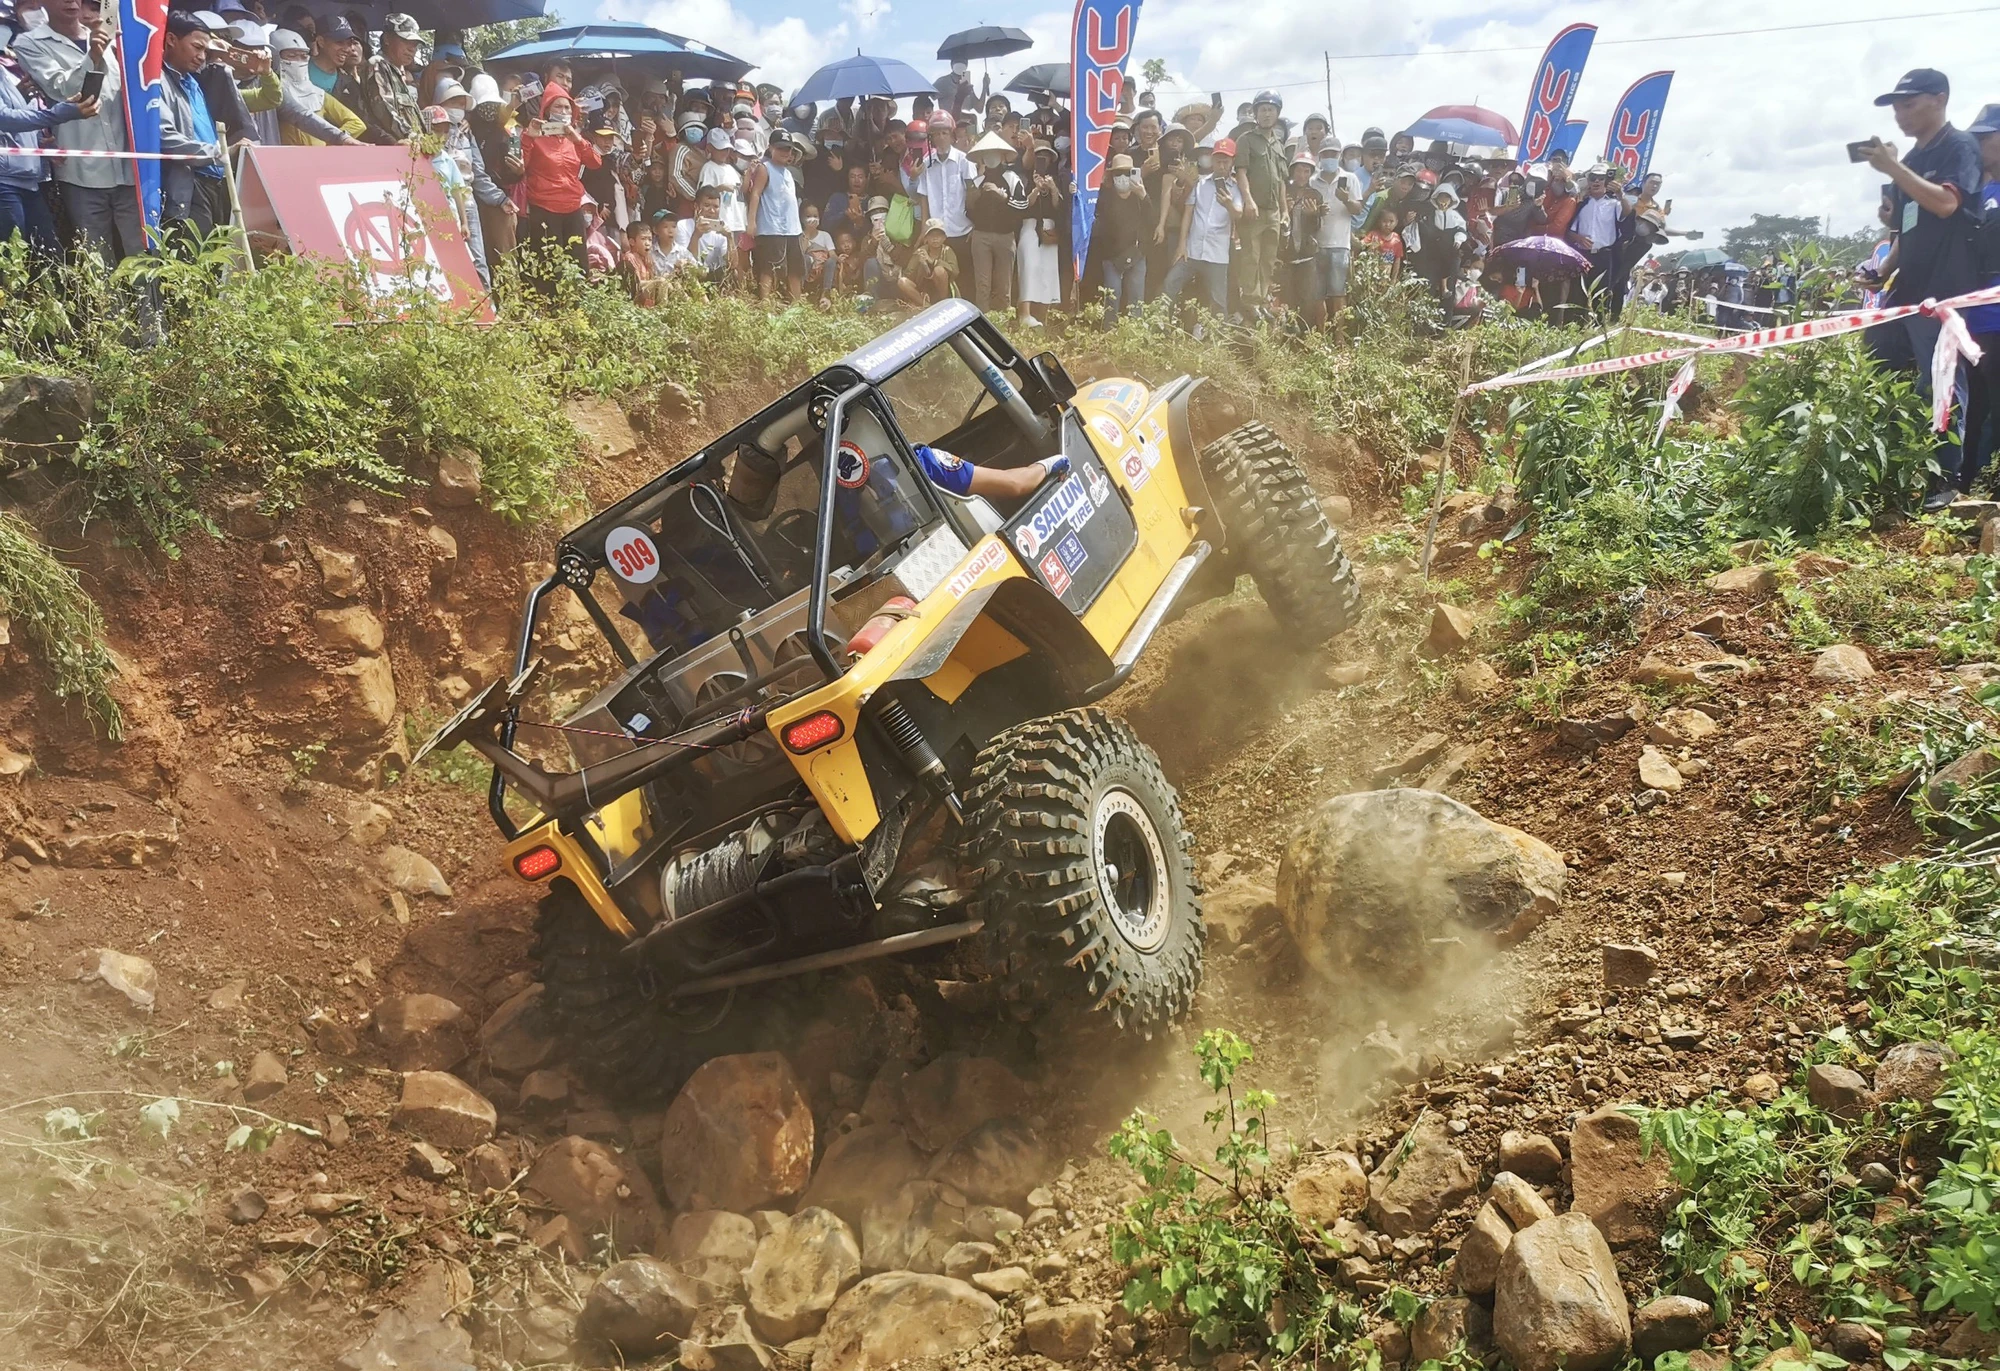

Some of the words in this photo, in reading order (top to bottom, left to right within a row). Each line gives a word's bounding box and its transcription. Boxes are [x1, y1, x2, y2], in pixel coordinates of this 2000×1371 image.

[857, 328, 922, 372] Schmierstoffe
[914, 302, 968, 337] Deutschland
[989, 365, 1013, 397] KING
[1033, 475, 1084, 540] SAILUN
[1069, 501, 1093, 530] TIRE
[612, 537, 656, 577] 309
